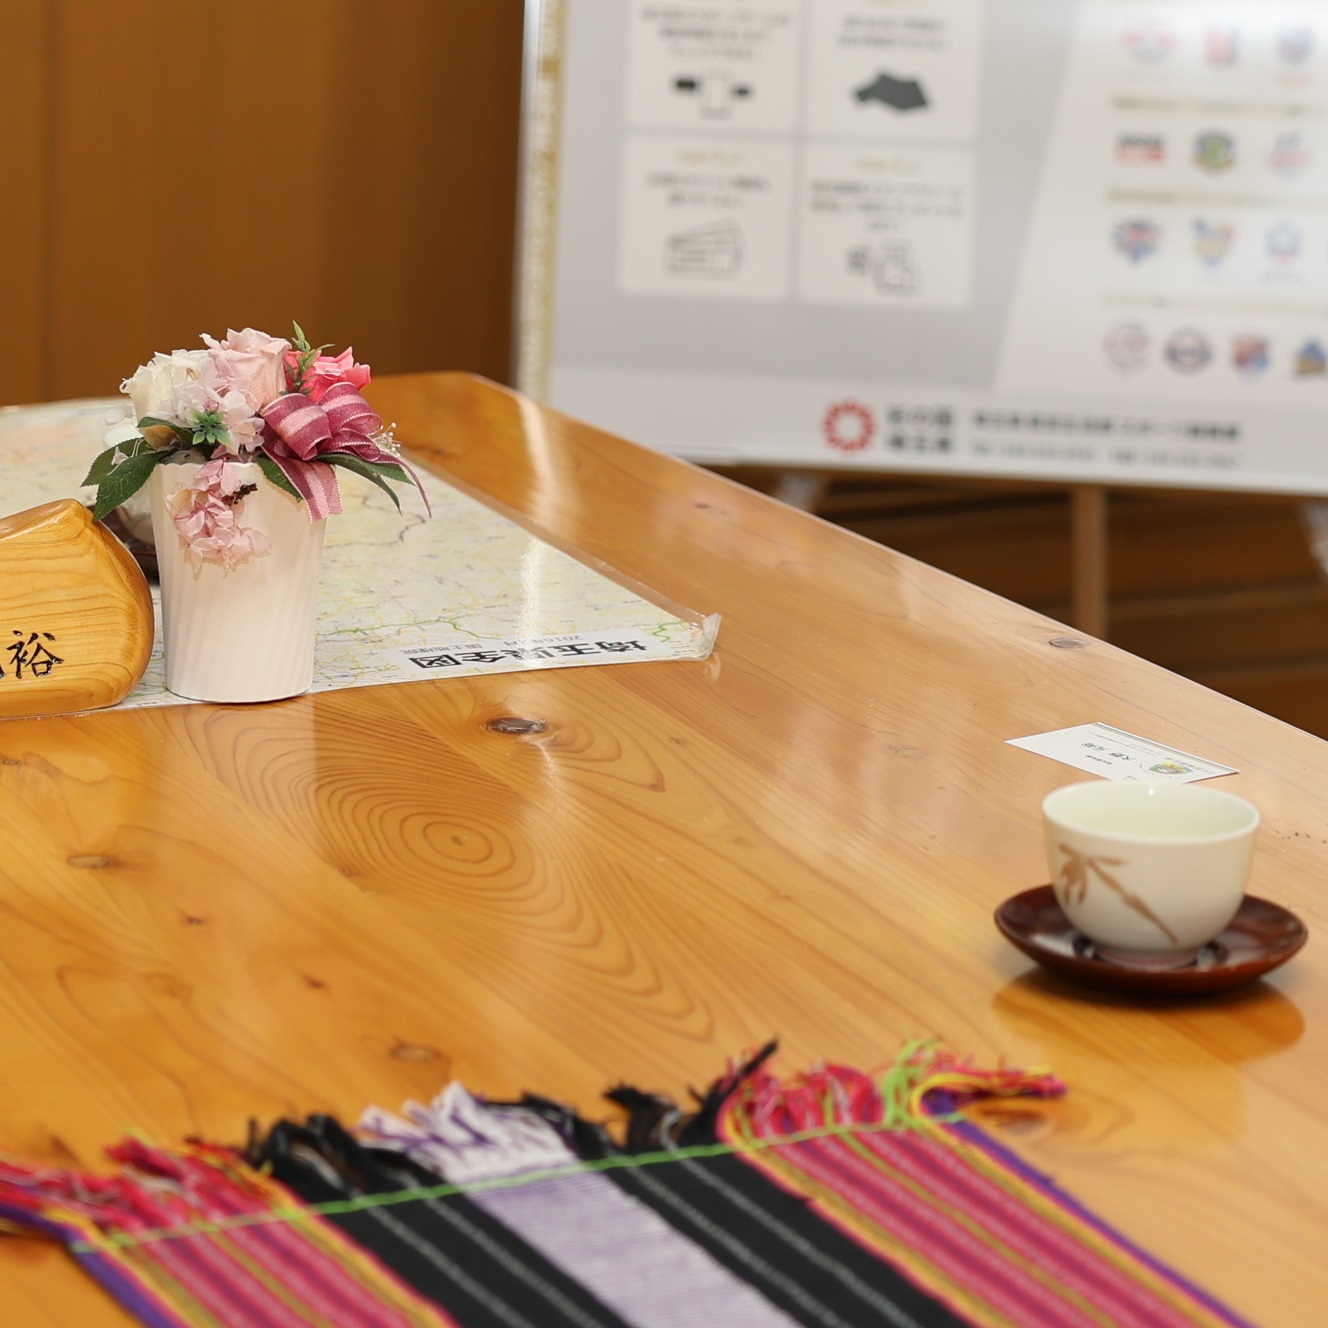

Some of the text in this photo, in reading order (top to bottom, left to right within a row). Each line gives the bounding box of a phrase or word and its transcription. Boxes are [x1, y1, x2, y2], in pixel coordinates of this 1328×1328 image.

[408, 639, 648, 670] 埼玉県全図
